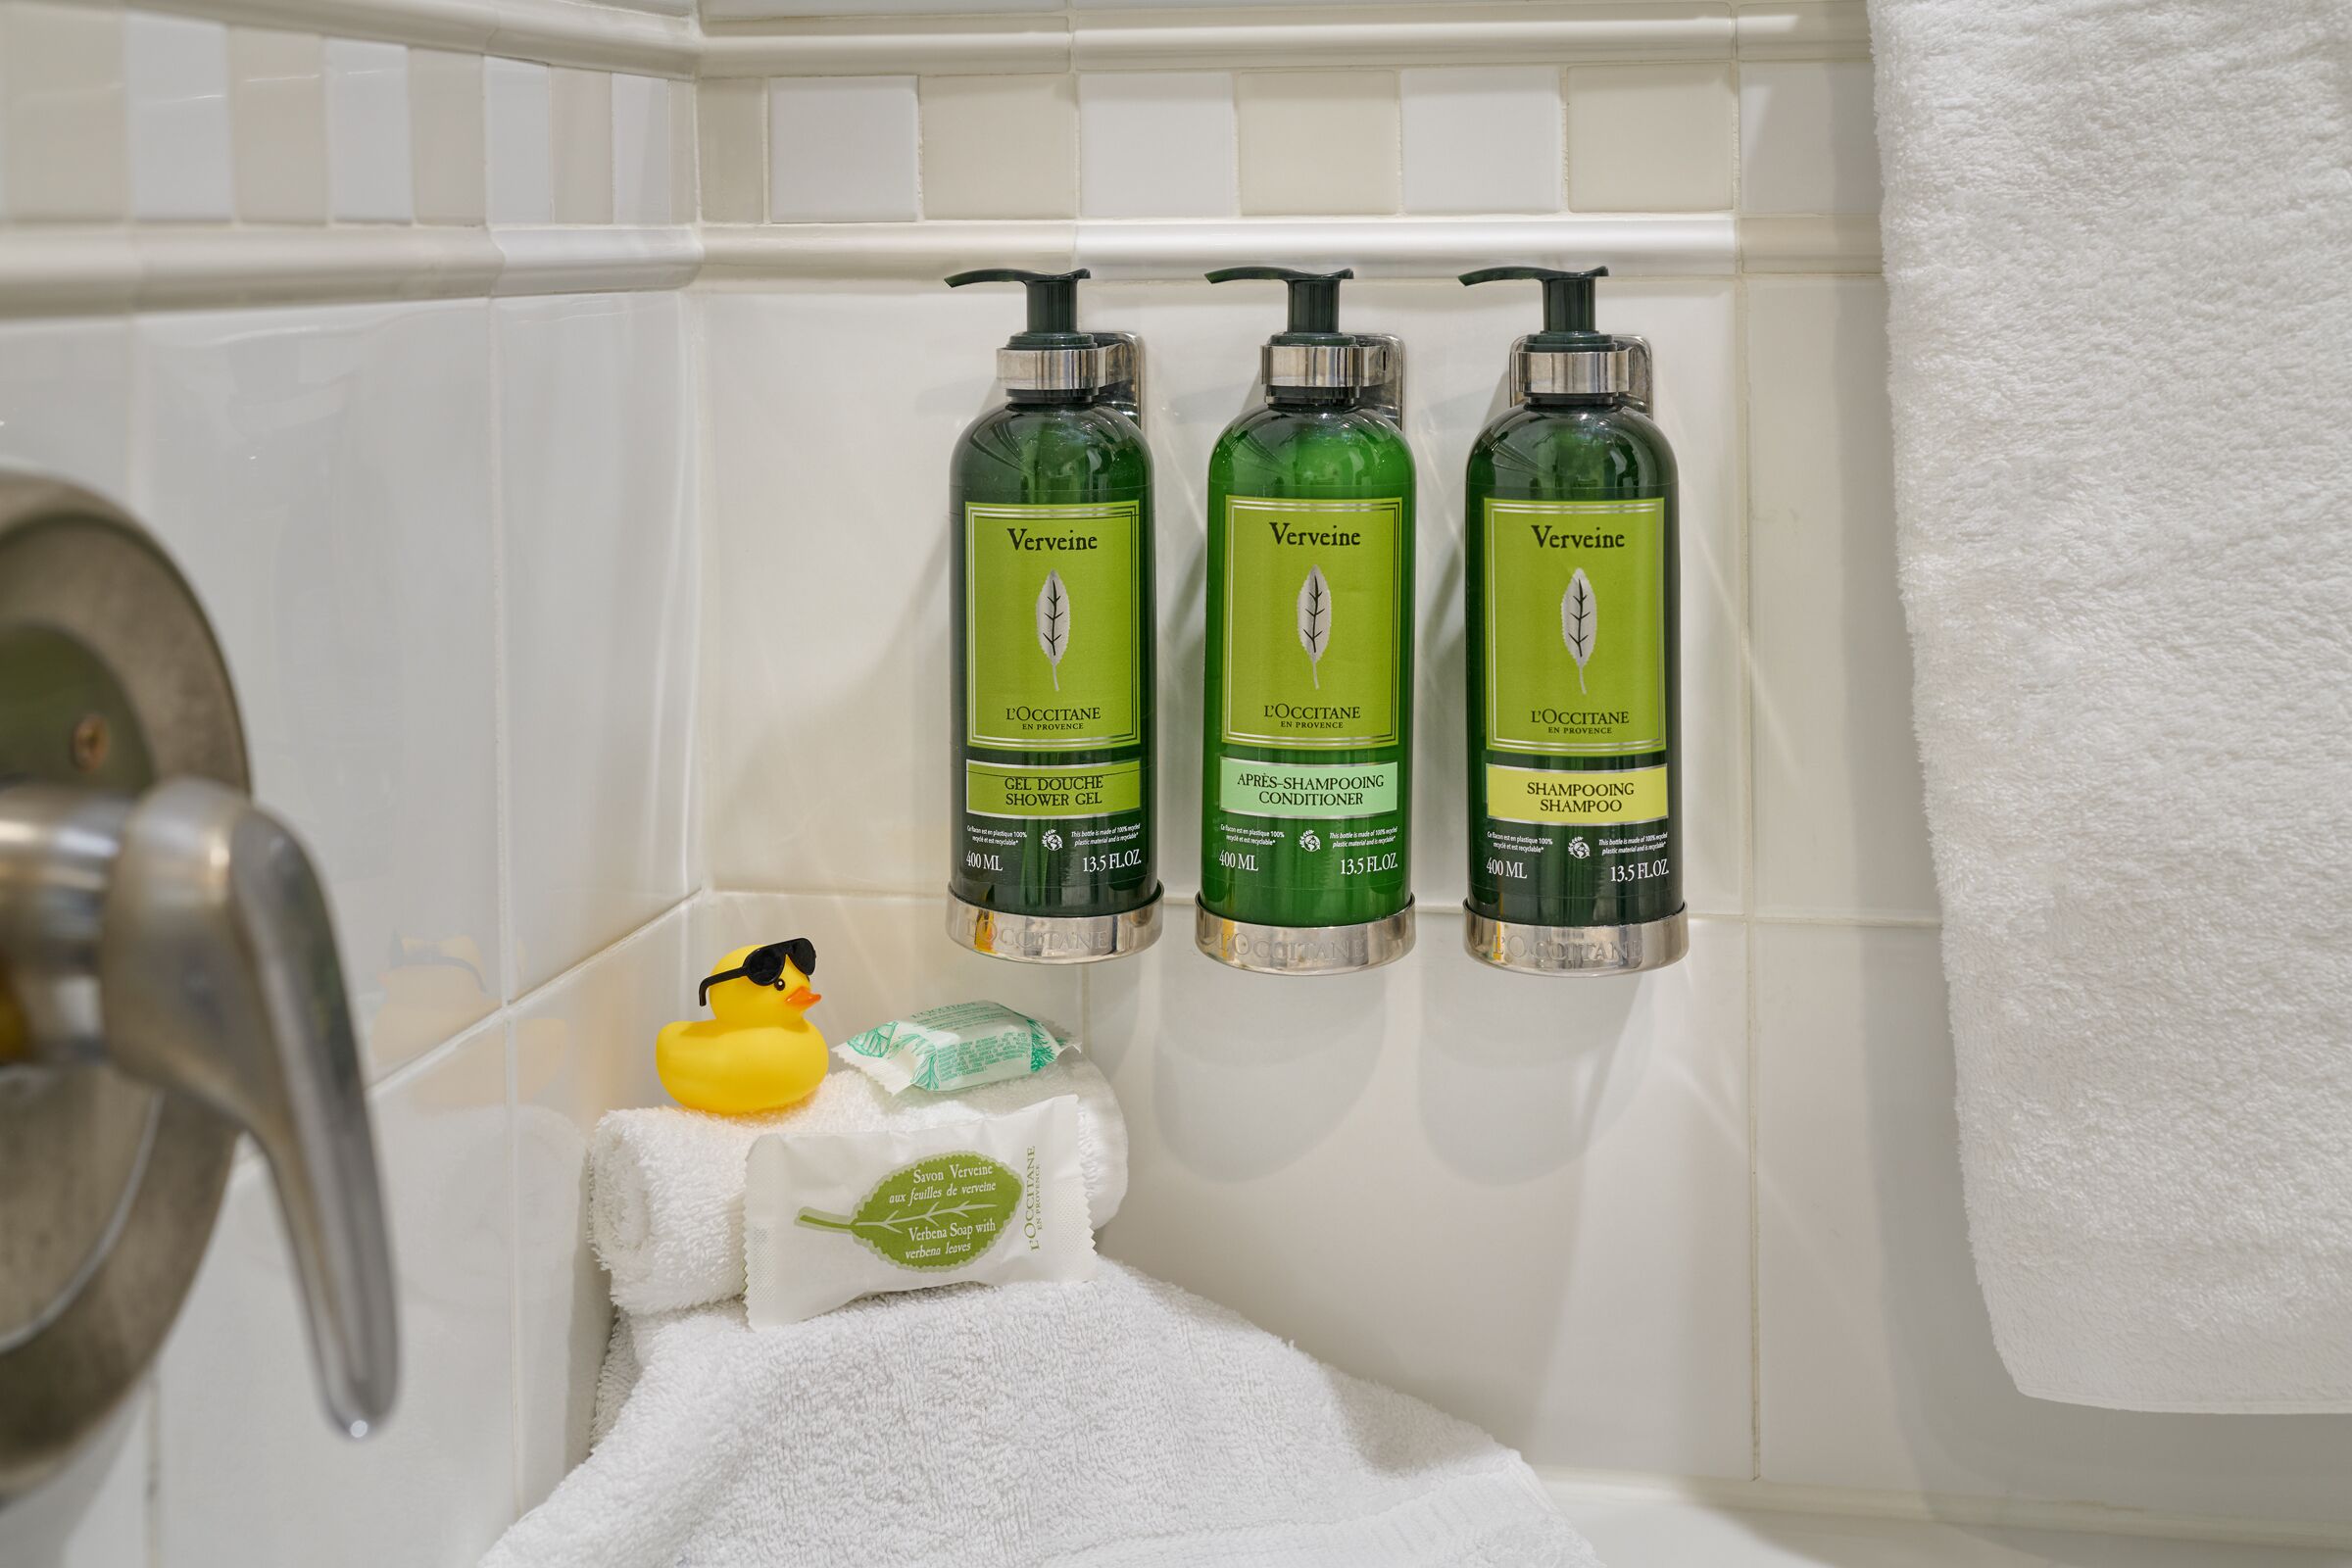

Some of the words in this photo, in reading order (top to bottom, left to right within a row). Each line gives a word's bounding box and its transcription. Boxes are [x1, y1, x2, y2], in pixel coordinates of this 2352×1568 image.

[1006, 527, 1098, 551] Verveine
[1269, 522, 1360, 546] Verveine
[1532, 525, 1625, 549] Verveine
[1005, 706, 1102, 721] L'OCCITANE
[1264, 703, 1360, 719] L'OCCITANE
[1531, 709, 1630, 724] L'OCCITANE
[1004, 777, 1032, 791] GEL
[1038, 775, 1103, 791] DOUCHE
[1527, 782, 1635, 797] SHAMPOOING
[1005, 793, 1069, 807] SHOWER
[1075, 792, 1102, 806] GEL
[1258, 791, 1363, 807] CONDITIONER
[1540, 799, 1623, 813] SHAMPOO
[966, 851, 982, 868] 400
[984, 855, 1004, 871] ML
[1083, 855, 1106, 872] 13.5
[1219, 850, 1235, 868] 400
[1238, 854, 1258, 871] ML
[1341, 858, 1364, 875] 13.5
[1487, 858, 1503, 876] 400
[1505, 860, 1527, 879] ML
[1611, 864, 1635, 882] 13.5
[913, 1169, 944, 1184] Savon
[949, 1162, 994, 1178] Verveine
[889, 1193, 906, 1203] aux
[907, 1188, 942, 1207] feuilles
[947, 1183, 957, 1197] de
[962, 1182, 996, 1194] verveine
[1024, 1147, 1040, 1250] L'OCCITANE
[907, 1227, 948, 1242] Verbena
[951, 1223, 973, 1240] Soap
[976, 1218, 996, 1232] with
[1036, 1217, 1042, 1230] EN
[906, 1246, 941, 1259] verbena
[946, 1242, 971, 1254] leaves
